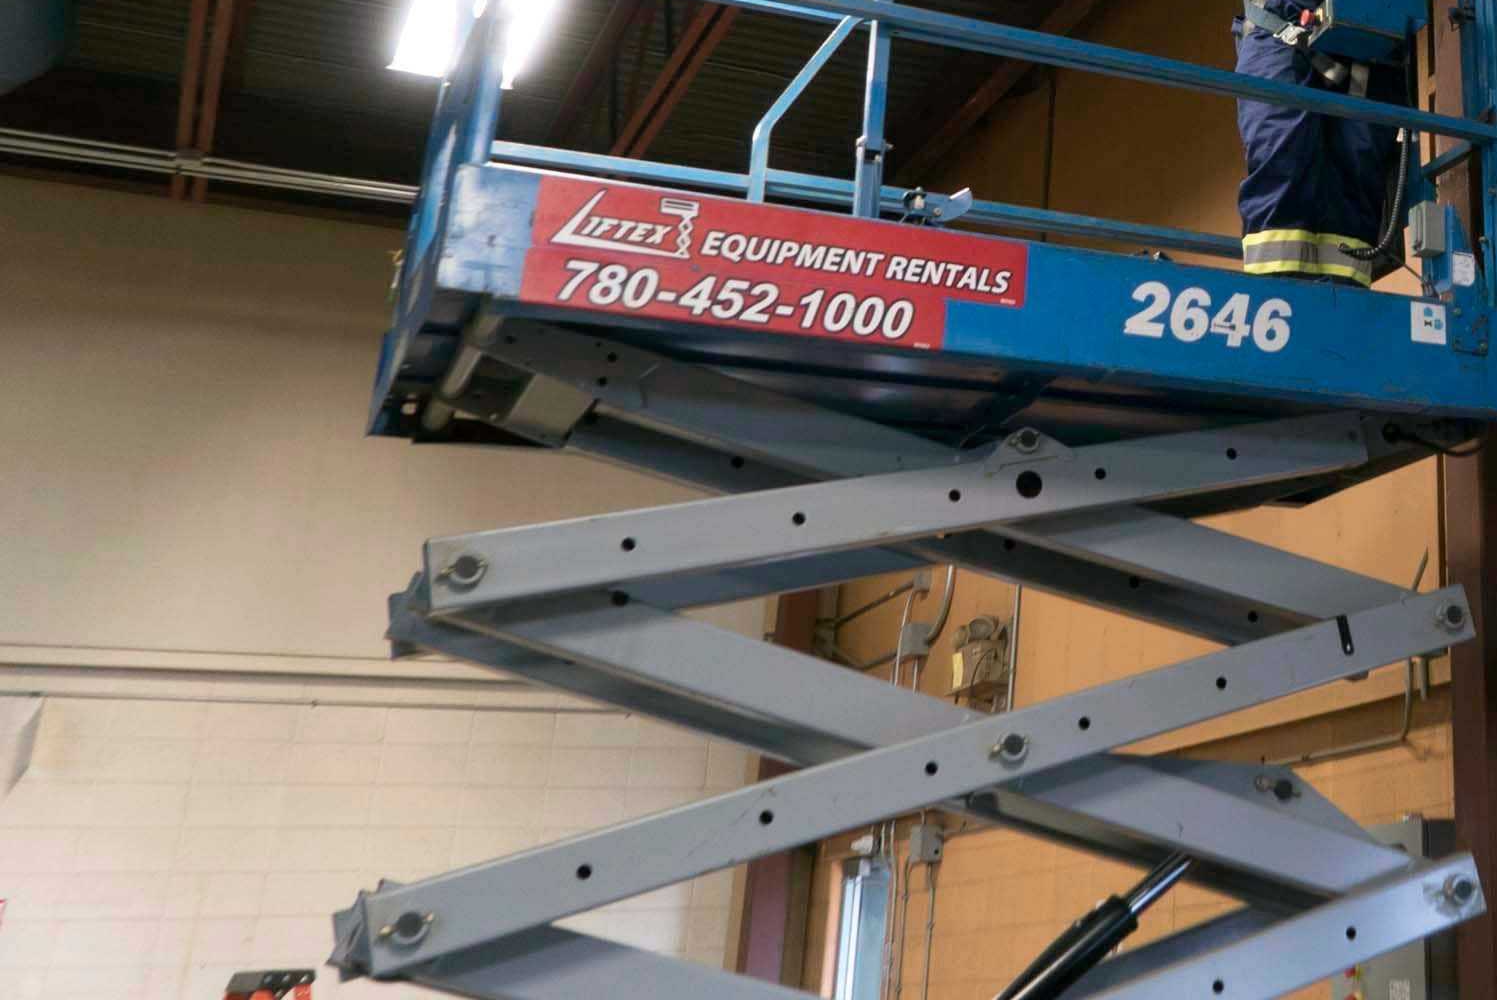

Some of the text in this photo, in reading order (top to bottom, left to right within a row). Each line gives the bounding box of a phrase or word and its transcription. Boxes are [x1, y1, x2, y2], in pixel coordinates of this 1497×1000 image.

[550, 188, 1012, 295] LIFTEX EQUIPMENT RENTALS
[558, 259, 914, 339] 780-452-1000
[1123, 281, 1292, 352] 2646
